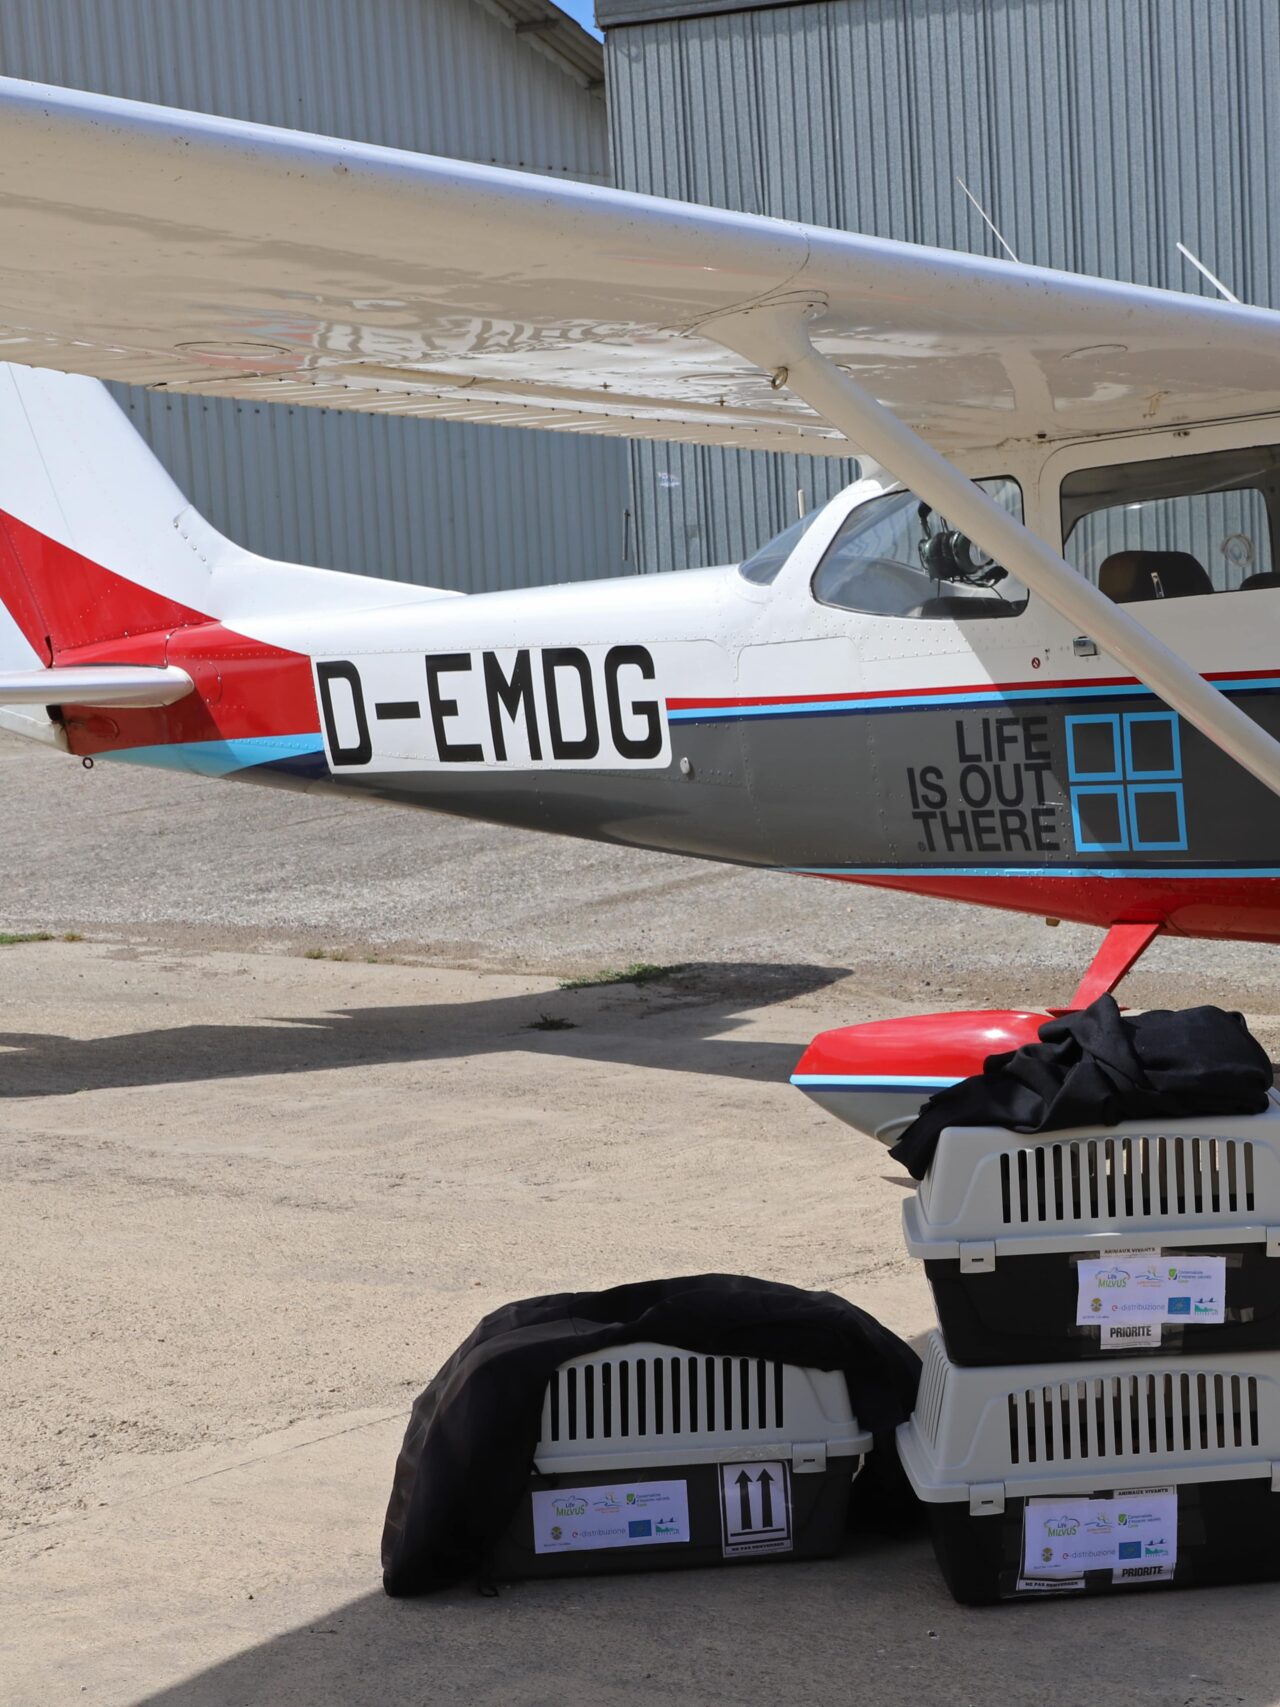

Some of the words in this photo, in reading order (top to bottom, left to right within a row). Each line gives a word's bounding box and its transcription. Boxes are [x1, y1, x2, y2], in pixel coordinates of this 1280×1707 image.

[316, 645, 662, 766] D-EMDG
[955, 716, 1050, 763] LIFE
[907, 766, 947, 809] IS
[959, 762, 1052, 808] OUT
[912, 808, 1060, 851] THERE
[1098, 1279, 1127, 1288] MILVUS
[1109, 1326, 1152, 1338] PRIORITE
[556, 1505, 585, 1517] MILVUS
[1048, 1525, 1077, 1537] MILVUS
[1121, 1566, 1164, 1577] PRIORITE
